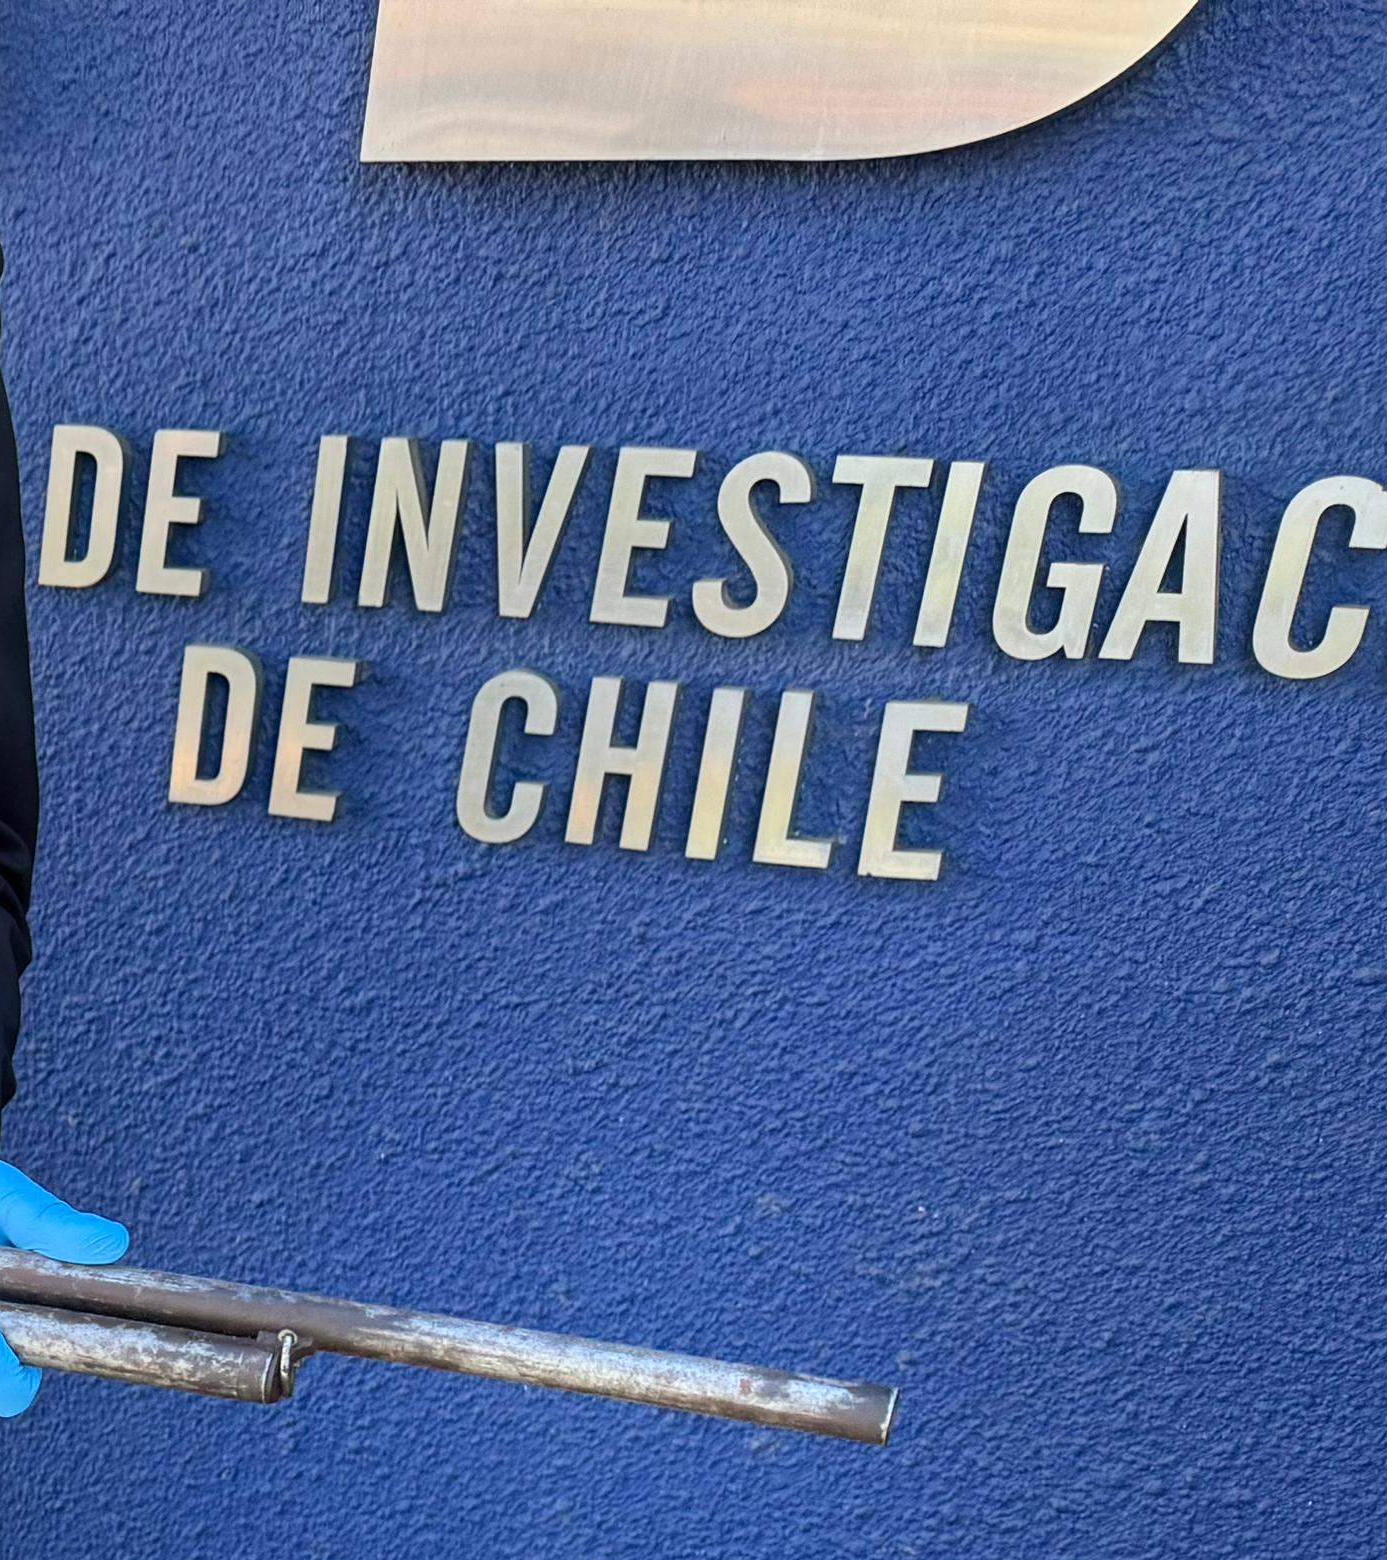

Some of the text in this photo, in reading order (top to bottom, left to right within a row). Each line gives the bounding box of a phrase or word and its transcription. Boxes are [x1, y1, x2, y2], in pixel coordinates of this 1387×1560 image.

[38, 420, 1387, 680] DE INVESTIGAC
[167, 639, 971, 882] DE CHILE
